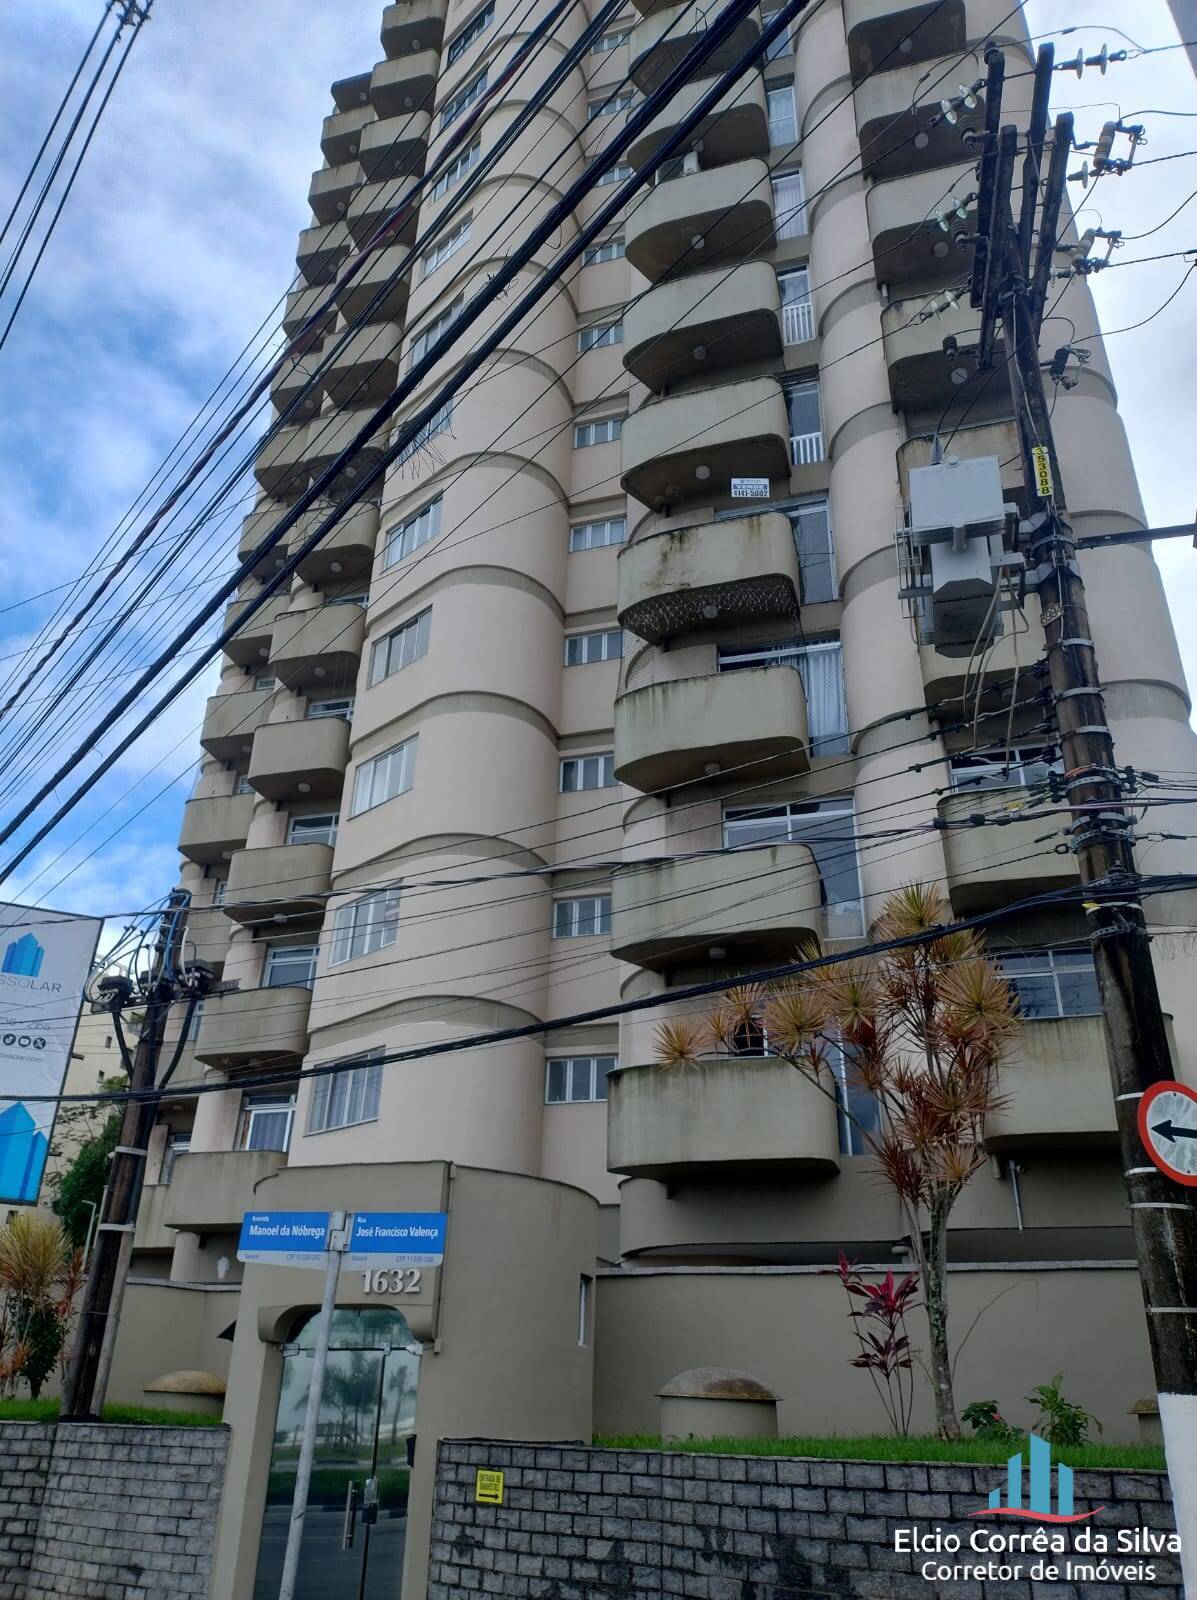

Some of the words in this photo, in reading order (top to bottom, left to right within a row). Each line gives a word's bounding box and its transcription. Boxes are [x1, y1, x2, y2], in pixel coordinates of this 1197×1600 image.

[1035, 447, 1050, 494] 353088
[249, 1225, 278, 1236] Manoel
[280, 1225, 290, 1236] da
[291, 1225, 326, 1239] Nóbrega
[356, 1226, 373, 1237] José
[374, 1226, 408, 1237] Francisco
[409, 1226, 439, 1239] Valença
[361, 1269, 421, 1294] 1632
